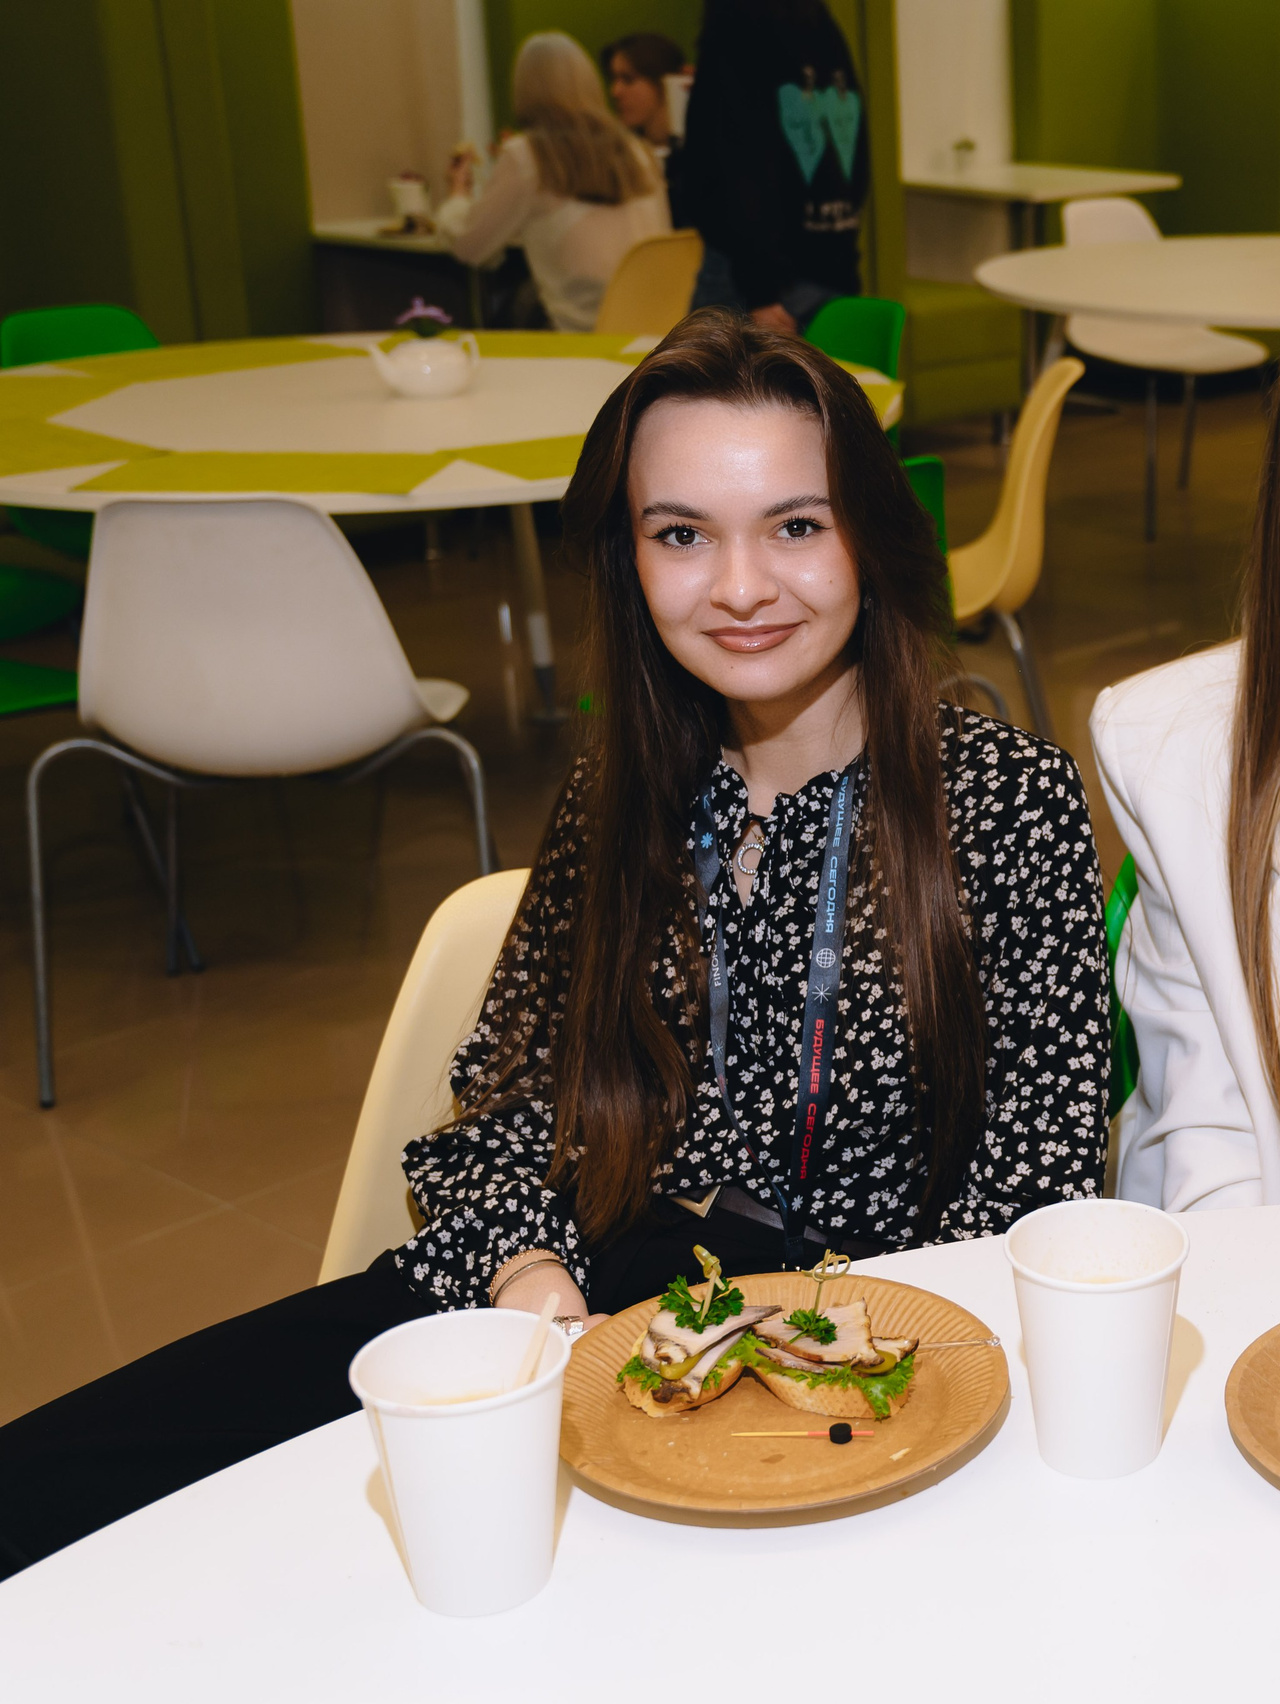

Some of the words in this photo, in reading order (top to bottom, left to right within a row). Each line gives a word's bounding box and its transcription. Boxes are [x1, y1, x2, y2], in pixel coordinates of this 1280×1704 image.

[832, 775, 849, 848] БУДУЩЕЕ
[825, 855, 838, 933] СЕГОДНЯ
[810, 1018, 825, 1095] БУДУЩЕЕ
[800, 1102, 817, 1179] СЕГОДНЯ
